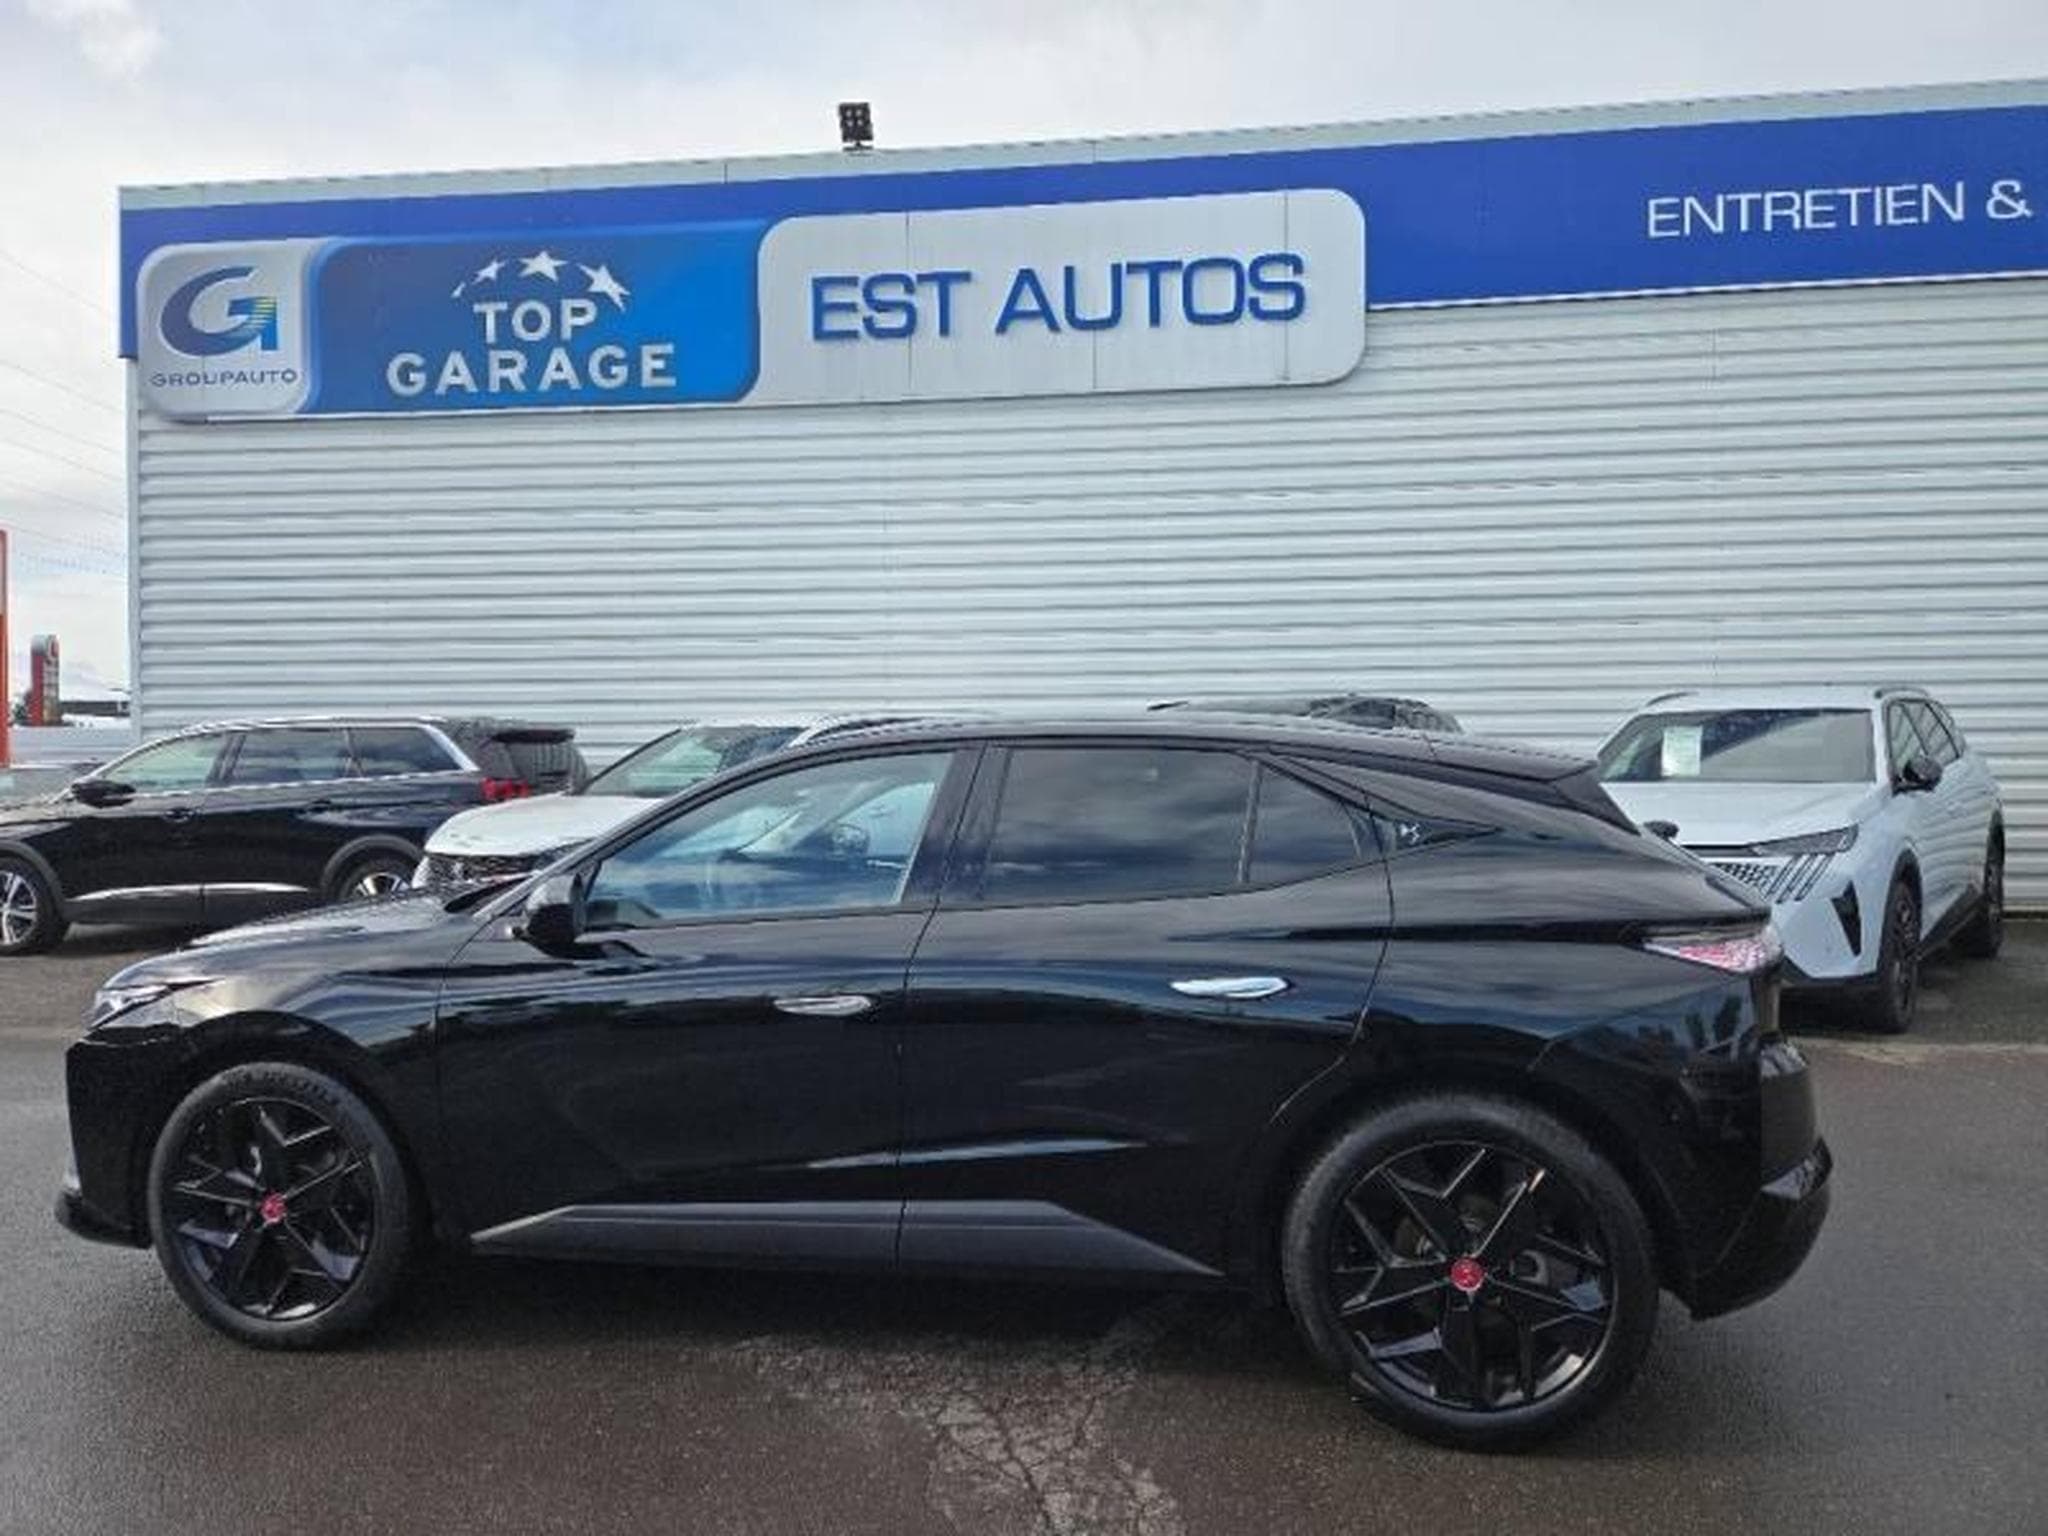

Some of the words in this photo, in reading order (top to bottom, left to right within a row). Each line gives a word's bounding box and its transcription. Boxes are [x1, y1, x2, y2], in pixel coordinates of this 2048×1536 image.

[1648, 181, 1965, 238] ENTRETIEN
[1986, 179, 2034, 219] &
[473, 299, 597, 343] TOP
[811, 270, 972, 341] EST
[995, 253, 1305, 334] AUTOS
[150, 368, 297, 388] GROUPAUTO
[386, 343, 677, 397] GARAGE
